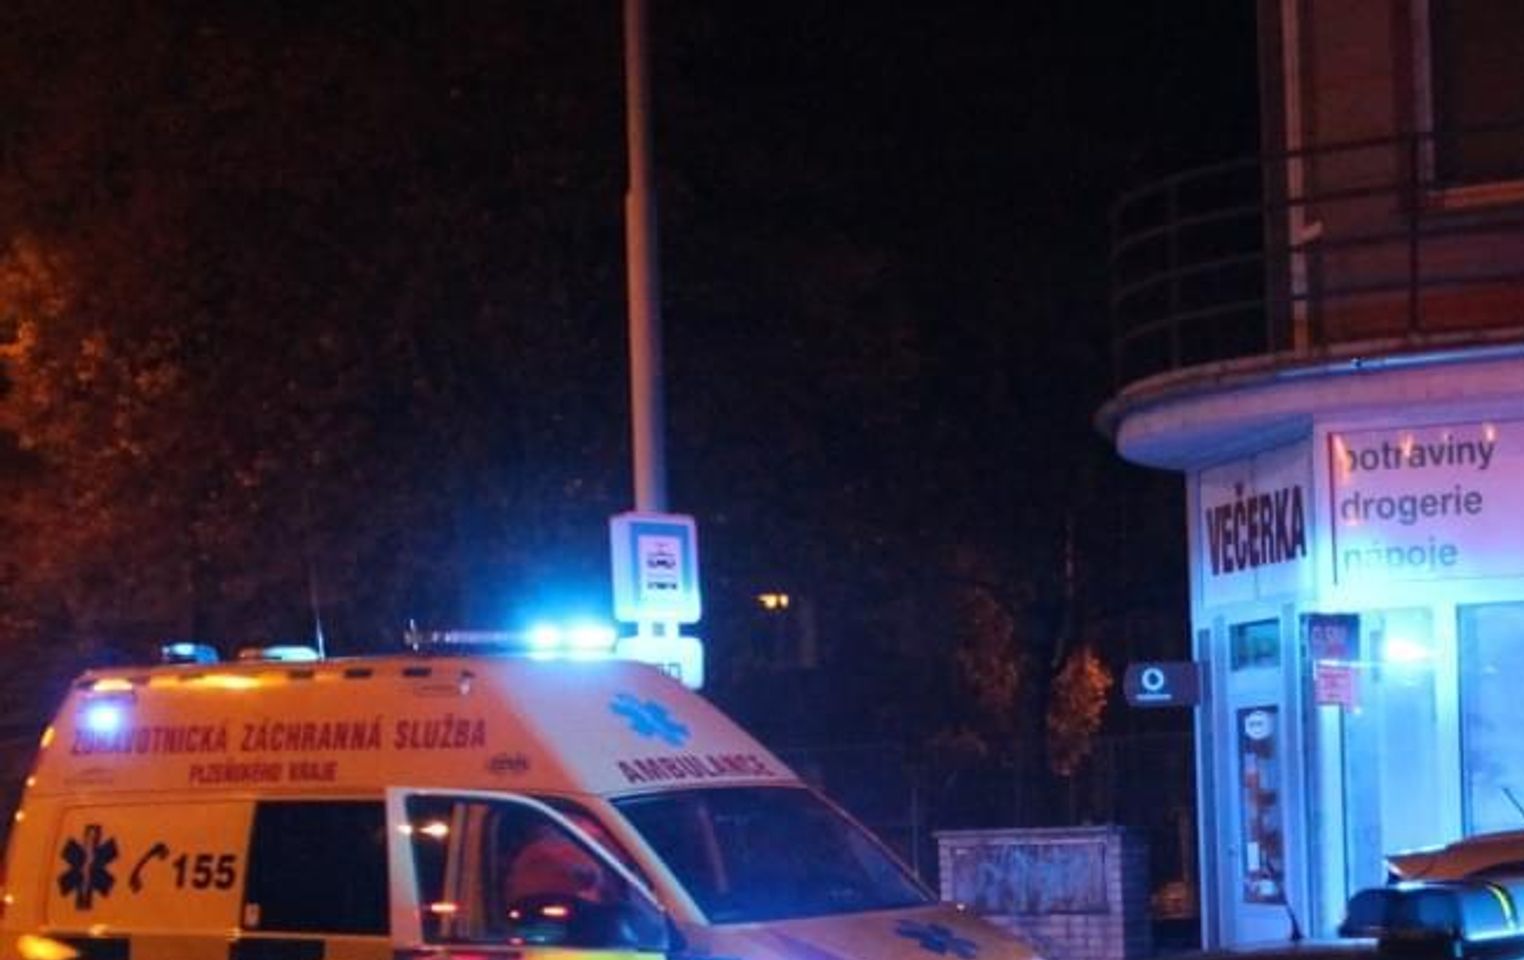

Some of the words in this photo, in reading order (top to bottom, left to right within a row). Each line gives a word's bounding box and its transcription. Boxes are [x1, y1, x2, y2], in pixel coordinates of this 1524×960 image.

[1341, 484, 1484, 526] drogerie
[1206, 482, 1307, 576] VEČERKA
[394, 712, 486, 750] SLUŽBA
[172, 853, 237, 891] 155
